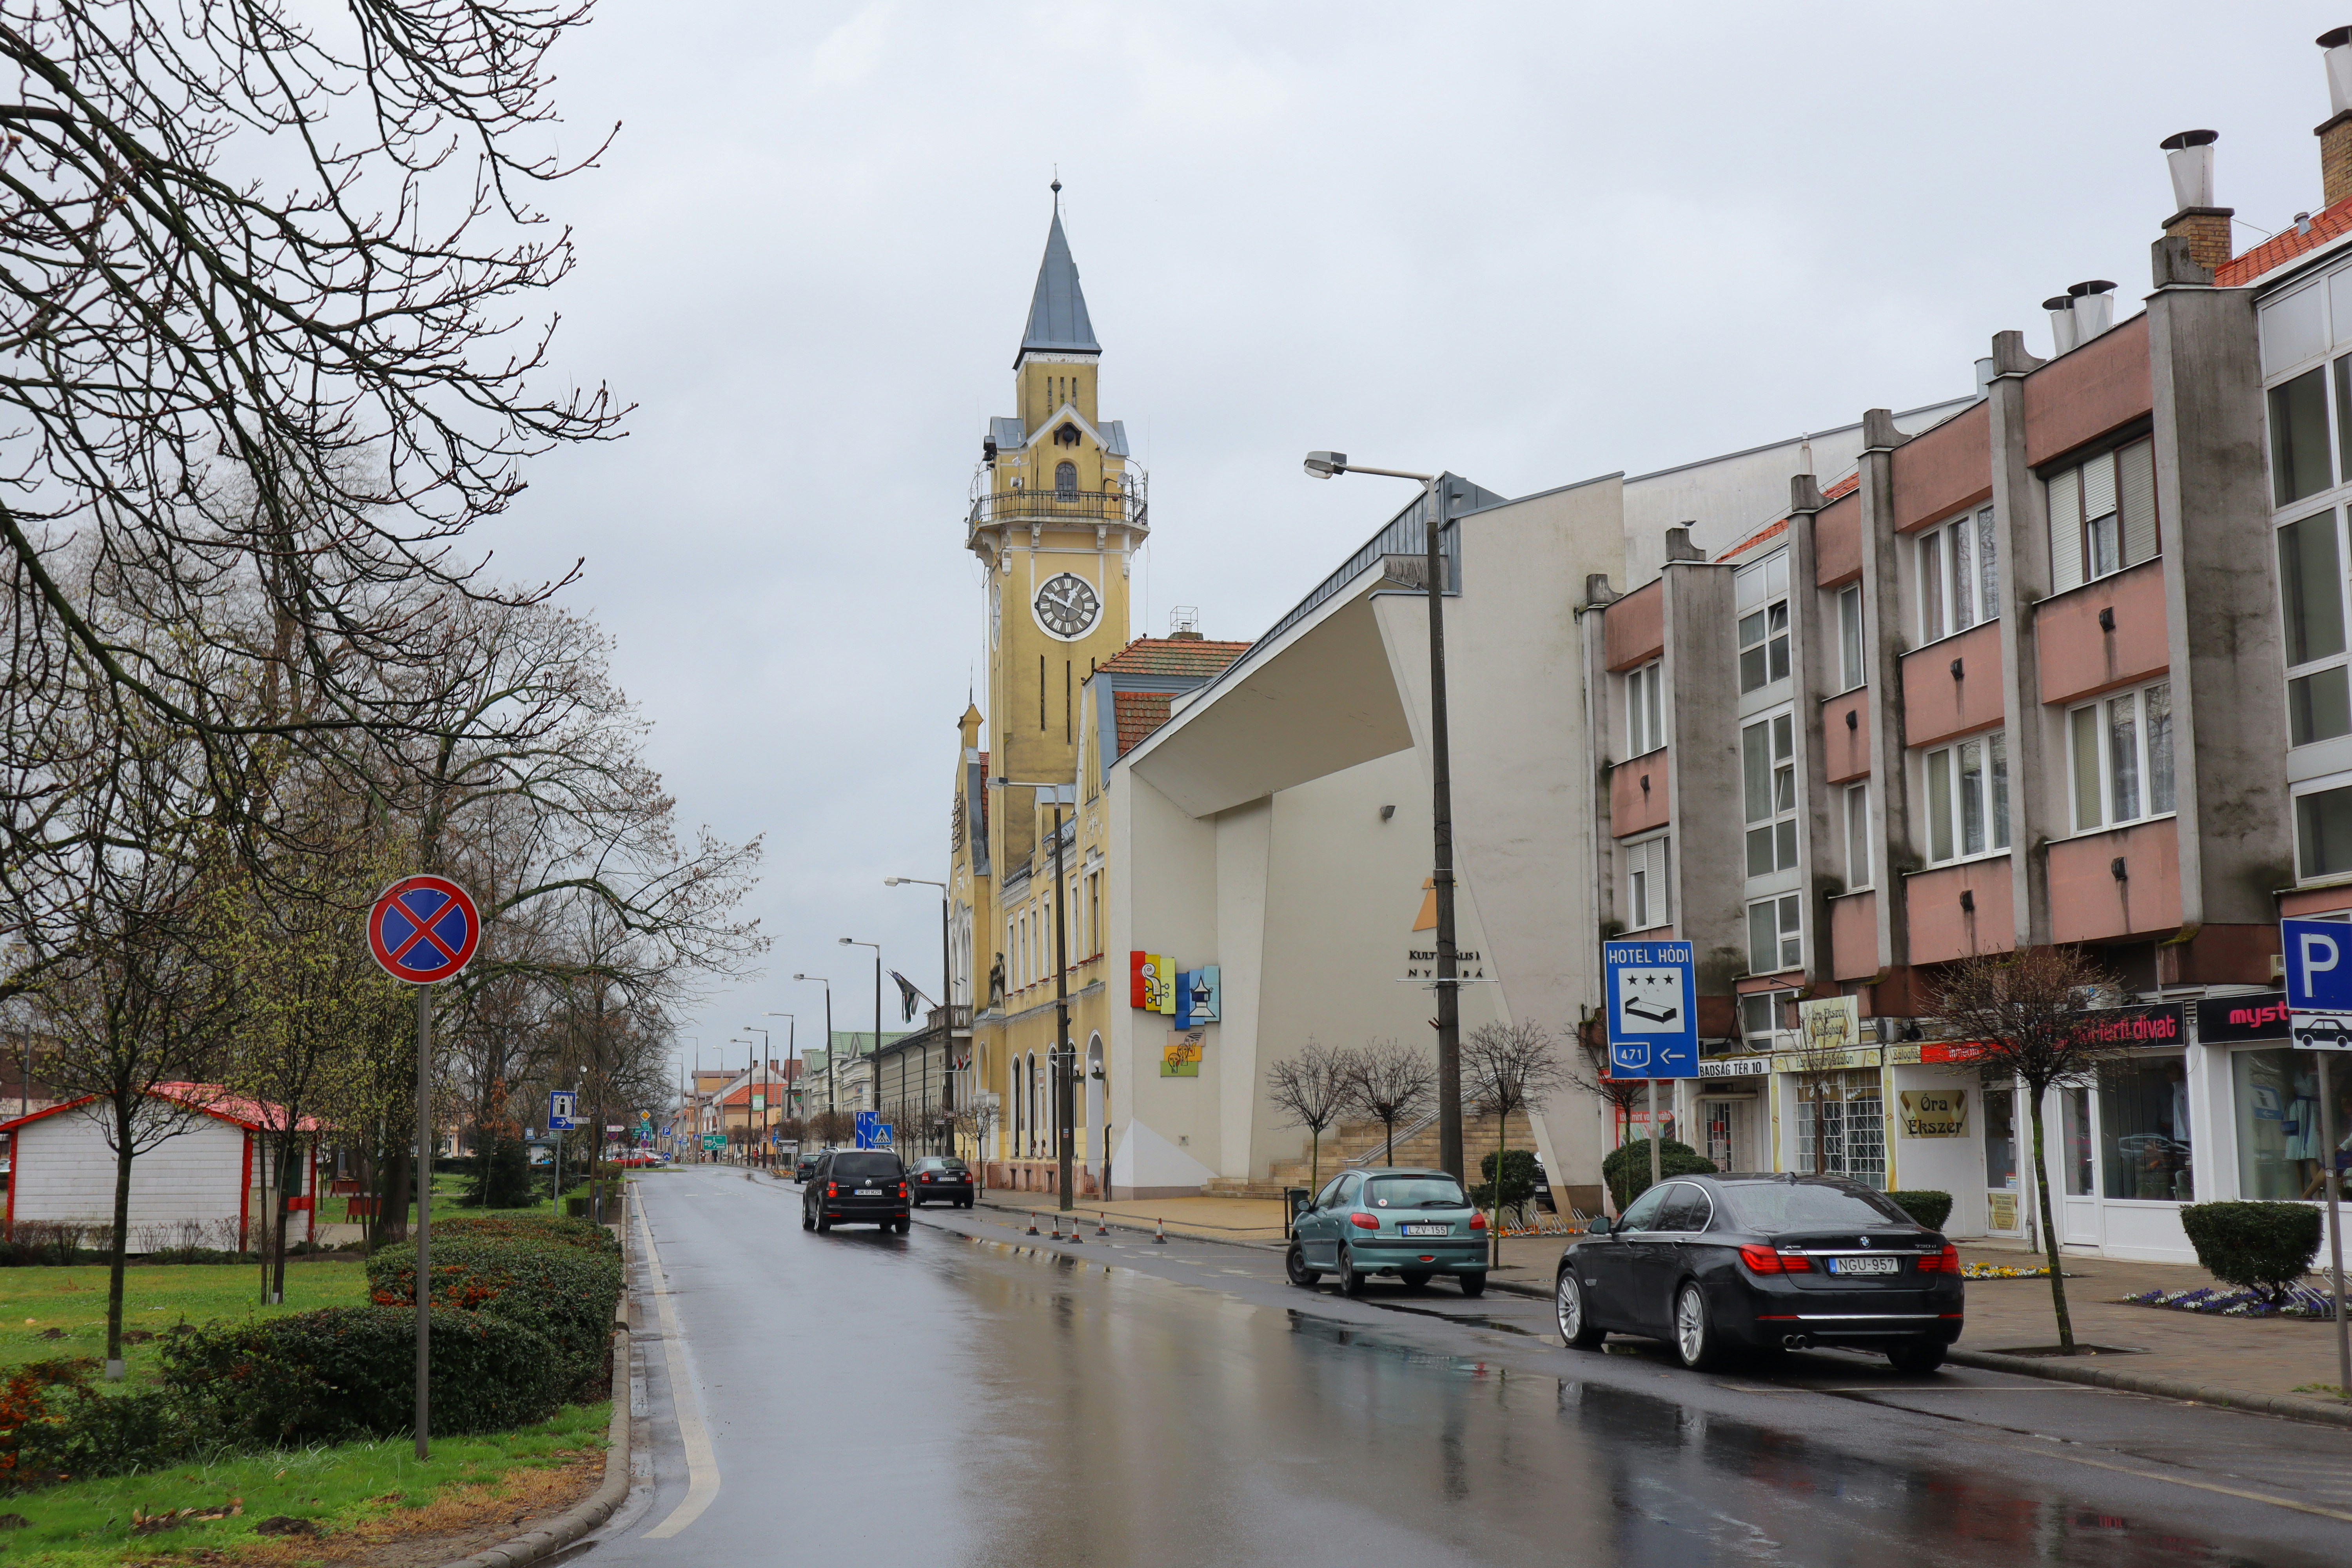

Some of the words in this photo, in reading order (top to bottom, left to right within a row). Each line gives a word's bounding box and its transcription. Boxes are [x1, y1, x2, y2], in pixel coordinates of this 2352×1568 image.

[1051, 581, 1060, 592] XI
[1063, 579, 1072, 589] XII
[1076, 583, 1082, 592] I
[1081, 591, 1091, 600] II
[1043, 611, 1054, 624] VIII
[1052, 619, 1062, 631] VII
[1065, 622, 1071, 633] VI
[1076, 620, 1083, 630] V
[1609, 949, 1653, 964] HOTEL
[2300, 933, 2339, 998] P
[2229, 1001, 2293, 1028] myst
[1815, 1024, 1843, 1037] Záogház
[2133, 1014, 2176, 1040] divat
[1621, 1049, 1642, 1060] 471
[1733, 1060, 1749, 1075] TÉR
[1752, 1062, 1762, 1074] 10
[1921, 1093, 1948, 1111] Óra
[1632, 1112, 1643, 1121] mint
[1907, 1116, 1963, 1134] Ékszer
[1408, 1226, 1446, 1234] LZV-155
[1839, 1258, 1894, 1271] NGU-957
